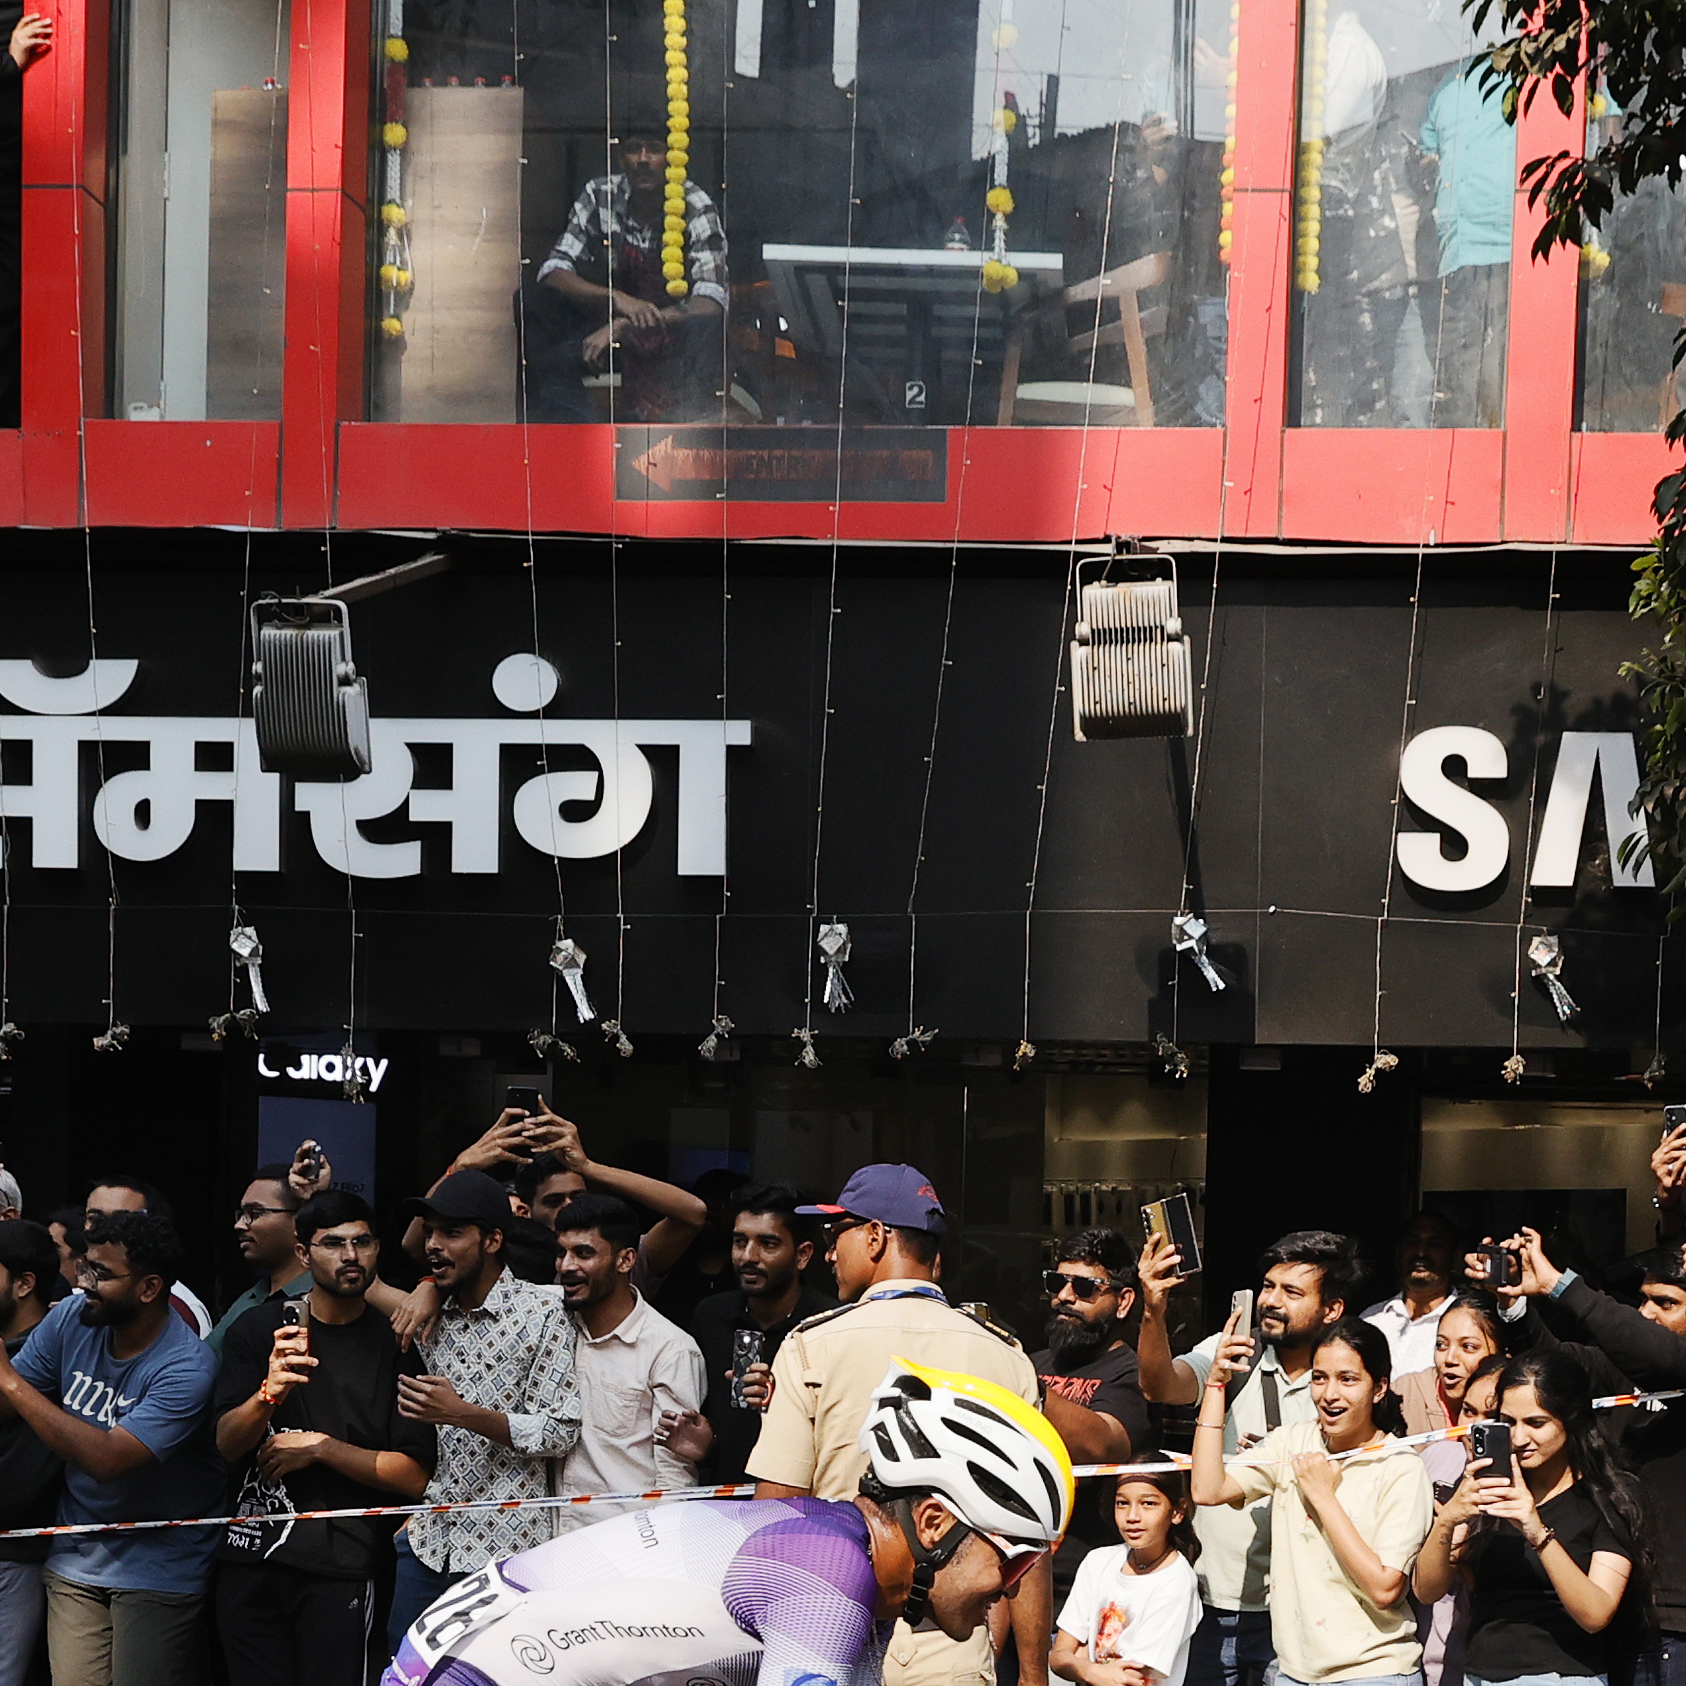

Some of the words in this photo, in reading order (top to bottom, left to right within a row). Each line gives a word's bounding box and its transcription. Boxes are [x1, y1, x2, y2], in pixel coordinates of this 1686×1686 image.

[906, 380, 926, 408] 2
[547, 1628, 602, 1651] Grant
[600, 1620, 706, 1640] Thornton
